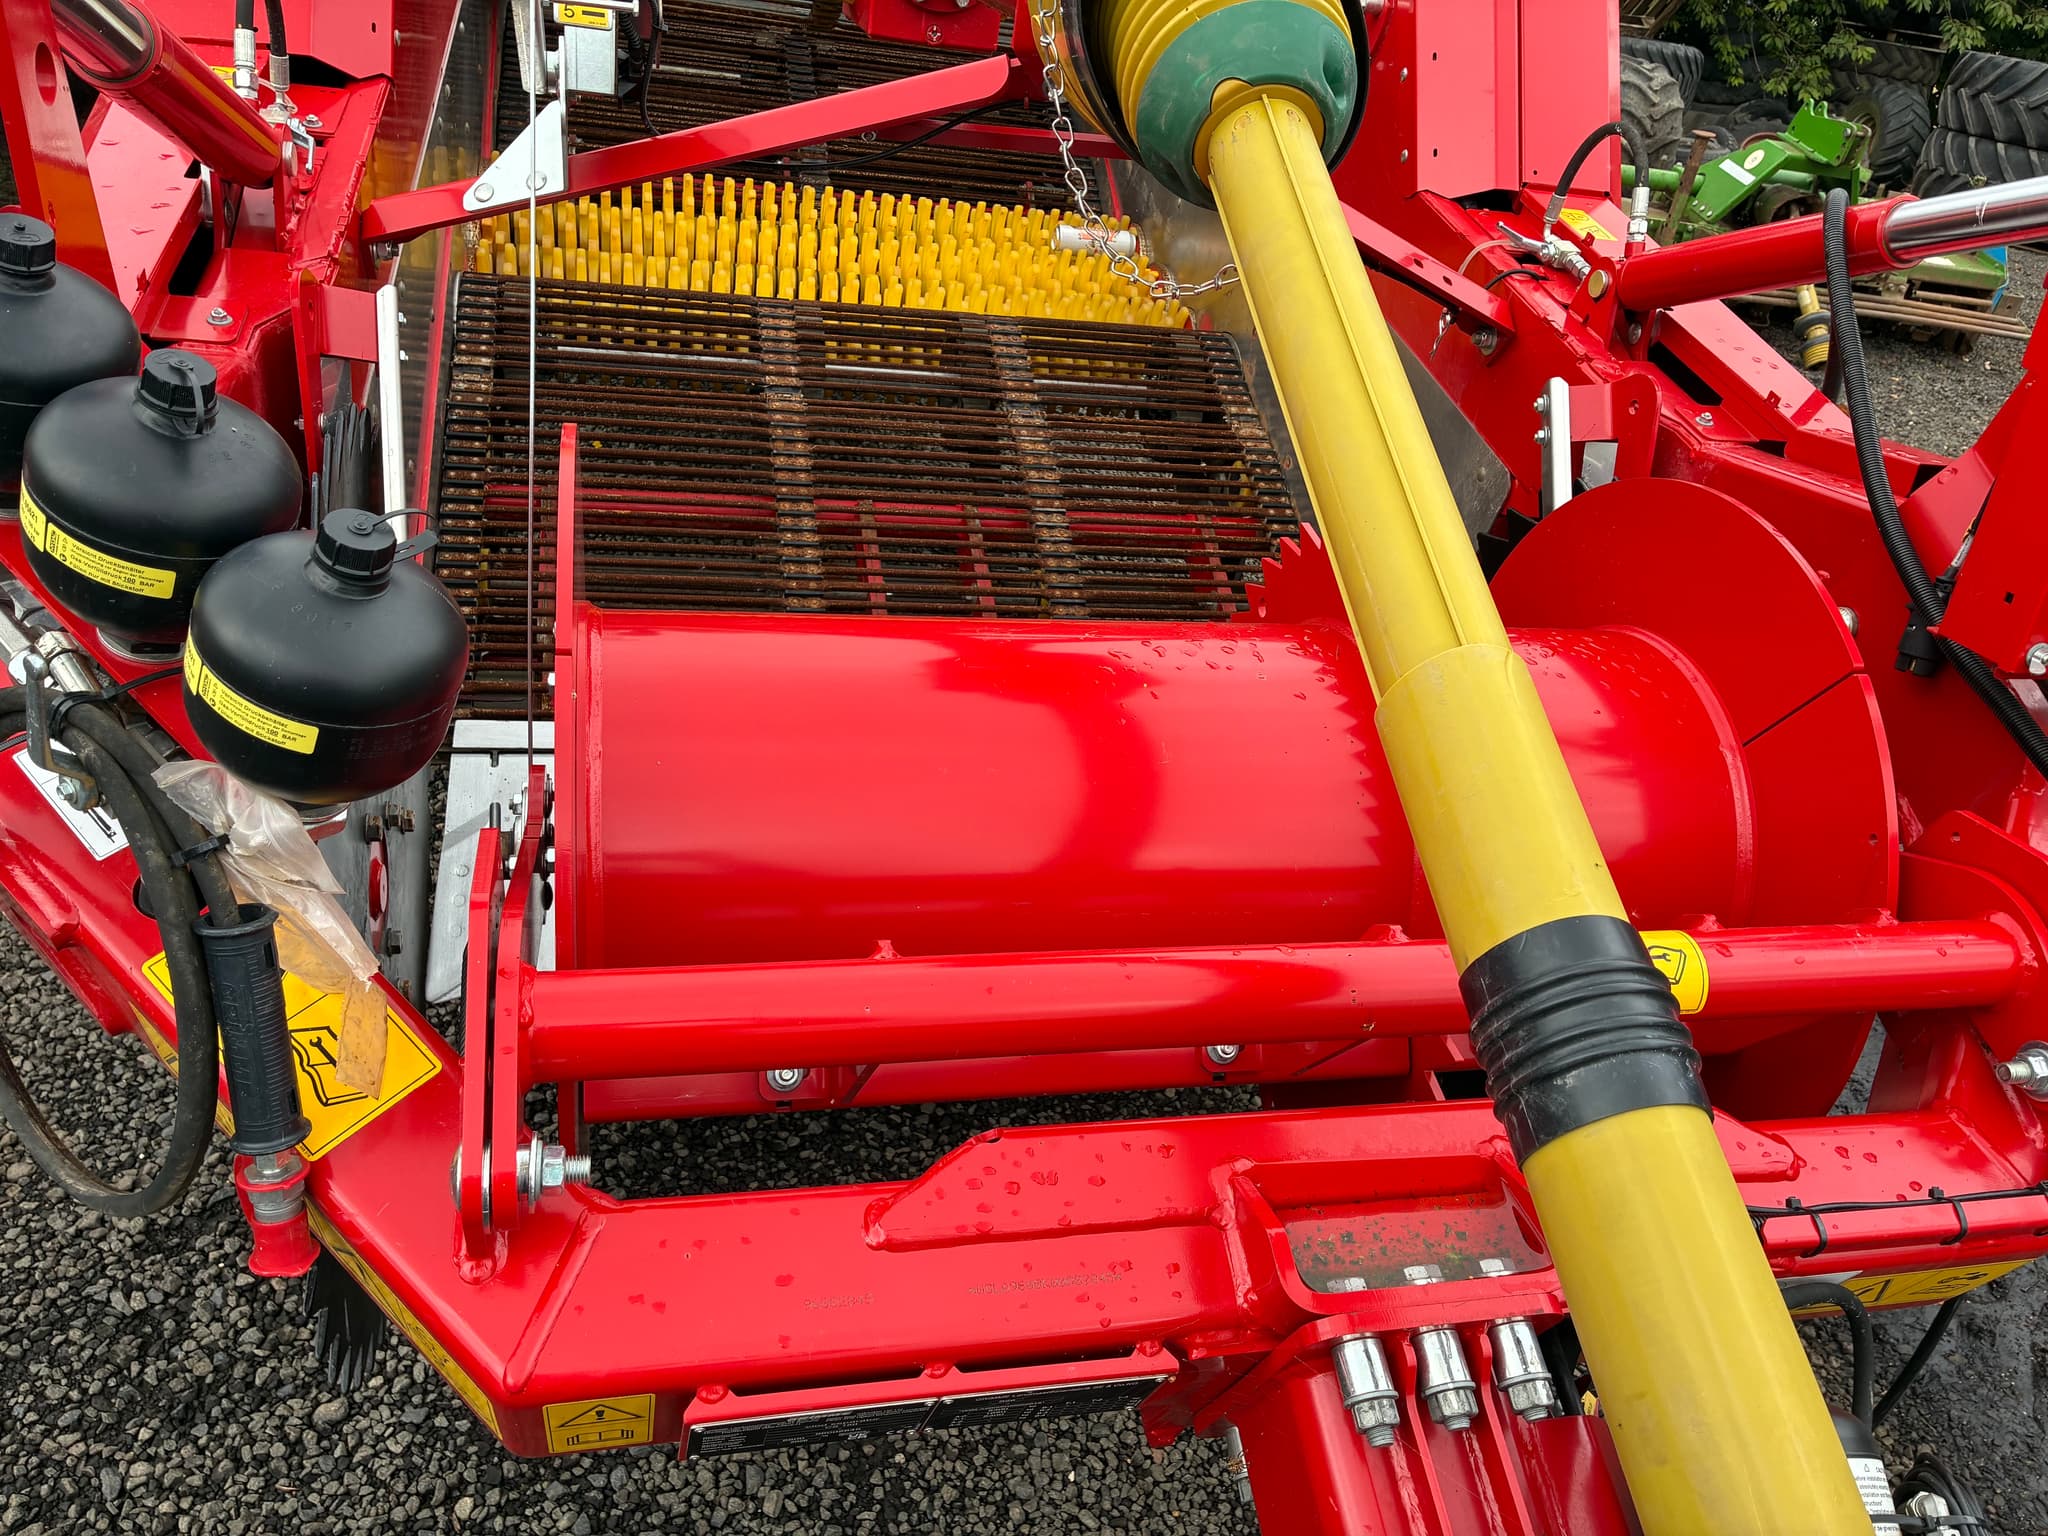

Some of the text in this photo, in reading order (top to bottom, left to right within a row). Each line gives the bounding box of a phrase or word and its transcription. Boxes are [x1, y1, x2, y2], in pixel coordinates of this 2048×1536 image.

[564, 4, 575, 18] 5
[122, 576, 136, 585] 100
[139, 580, 156, 588] BAR
[266, 727, 279, 736] 100
[282, 734, 297, 742] BAR
